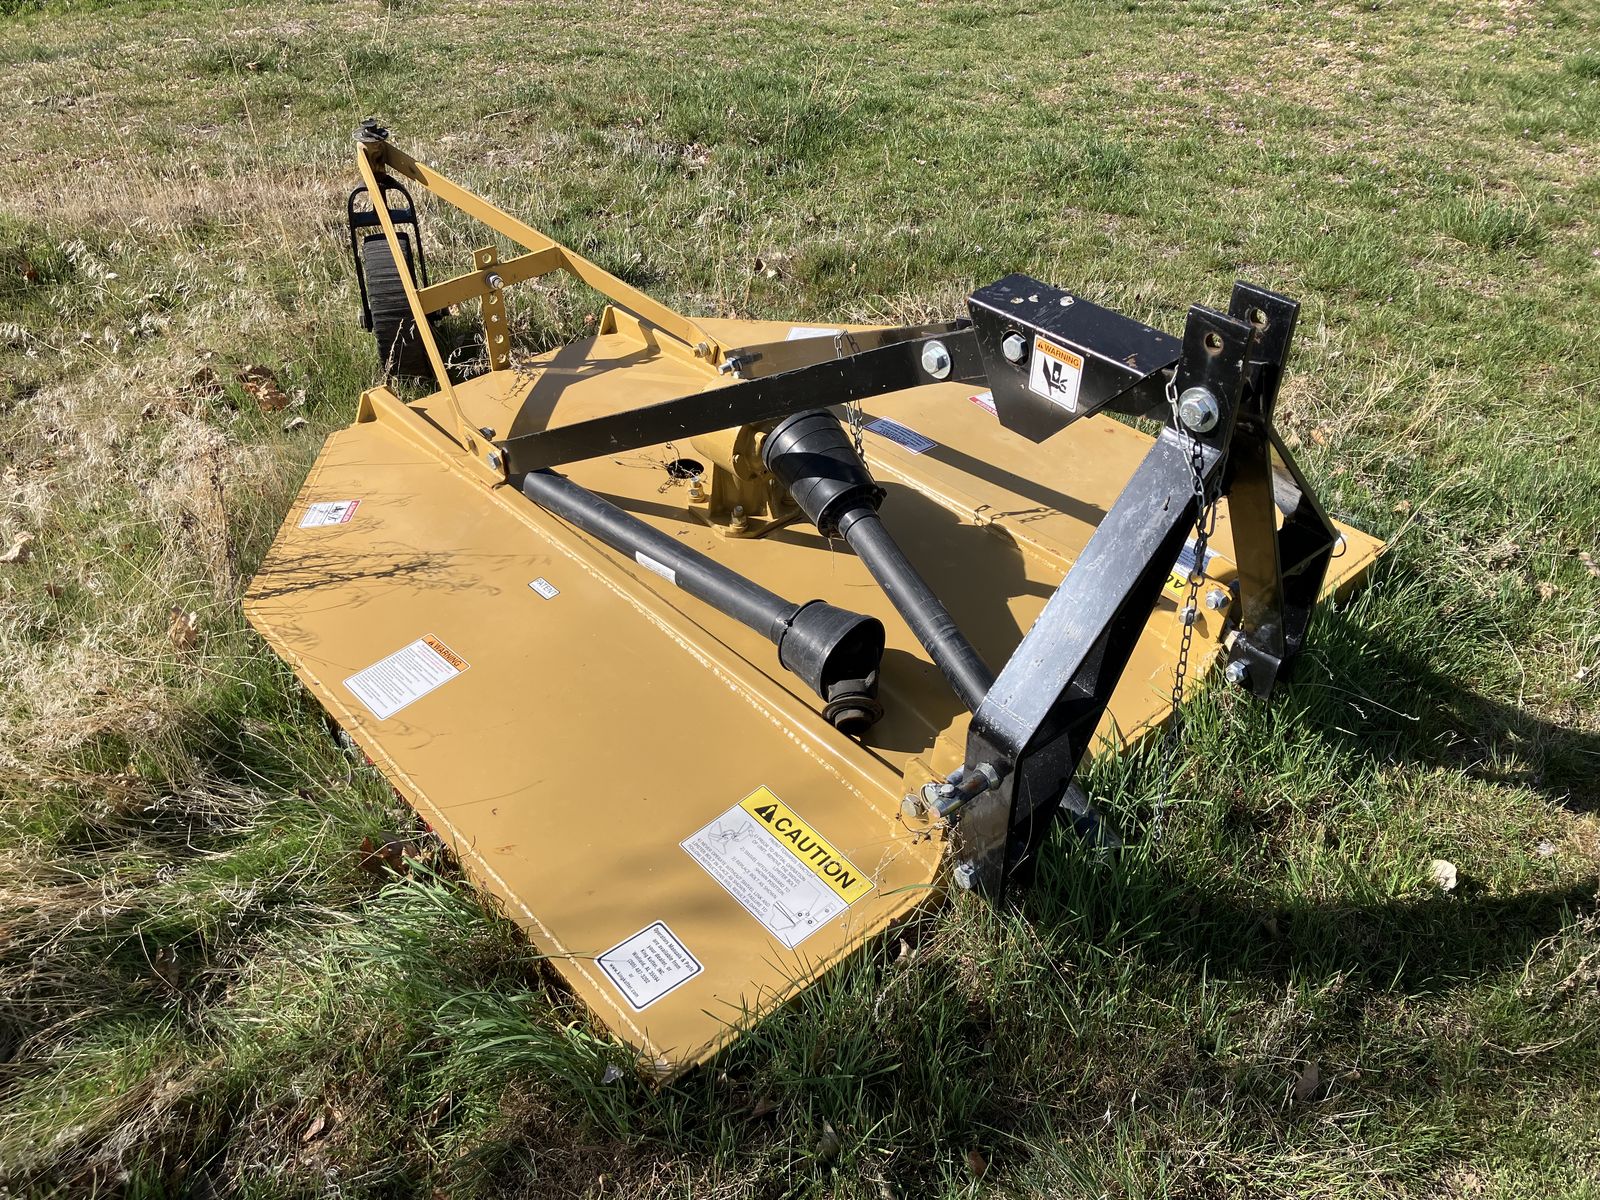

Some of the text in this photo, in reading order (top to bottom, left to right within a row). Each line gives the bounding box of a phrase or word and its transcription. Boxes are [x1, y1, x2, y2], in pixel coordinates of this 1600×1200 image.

[1044, 344, 1078, 366] WARNING
[536, 579, 557, 595] PATENT
[432, 642, 462, 666] WARNING
[757, 836, 769, 847] PRIOR
[772, 851, 787, 863] INITIAL
[785, 862, 806, 881] OPERATION
[774, 817, 857, 890] CAUTION
[686, 843, 701, 857] FOLLOW
[699, 856, 725, 879] INSTRUCTIONS
[722, 878, 733, 887] WILL
[731, 886, 745, 899] RESULT
[691, 840, 706, 853] LIMITER
[704, 852, 715, 862] BOLT
[717, 865, 729, 875] PLACE
[746, 892, 762, 907] FAILURE
[700, 841, 712, 852] NEVER
[709, 850, 727, 865] OPERATE
[724, 864, 742, 880] WITHOUT
[752, 891, 764, 900] LINK
[761, 898, 771, 907] AND
[734, 859, 750, 873] REPLACE
[748, 872, 760, 882] BOLT
[755, 861, 768, 872] HITCH
[766, 871, 785, 888] FORWARD
[766, 852, 781, 866] REMOVE
[786, 871, 801, 884] SWIVEL
[772, 866, 788, 880] LIMITER
[639, 948, 649, 957] King
[646, 956, 659, 969] Kutter,
[646, 944, 656, 954] your
[654, 952, 669, 967] dealer,
[652, 927, 670, 945] Operators
[667, 943, 683, 959] Manuals
[683, 960, 695, 972] Parts
[657, 943, 674, 961] available
[671, 959, 682, 969] from
[608, 963, 639, 998] www.kingkutter.com
